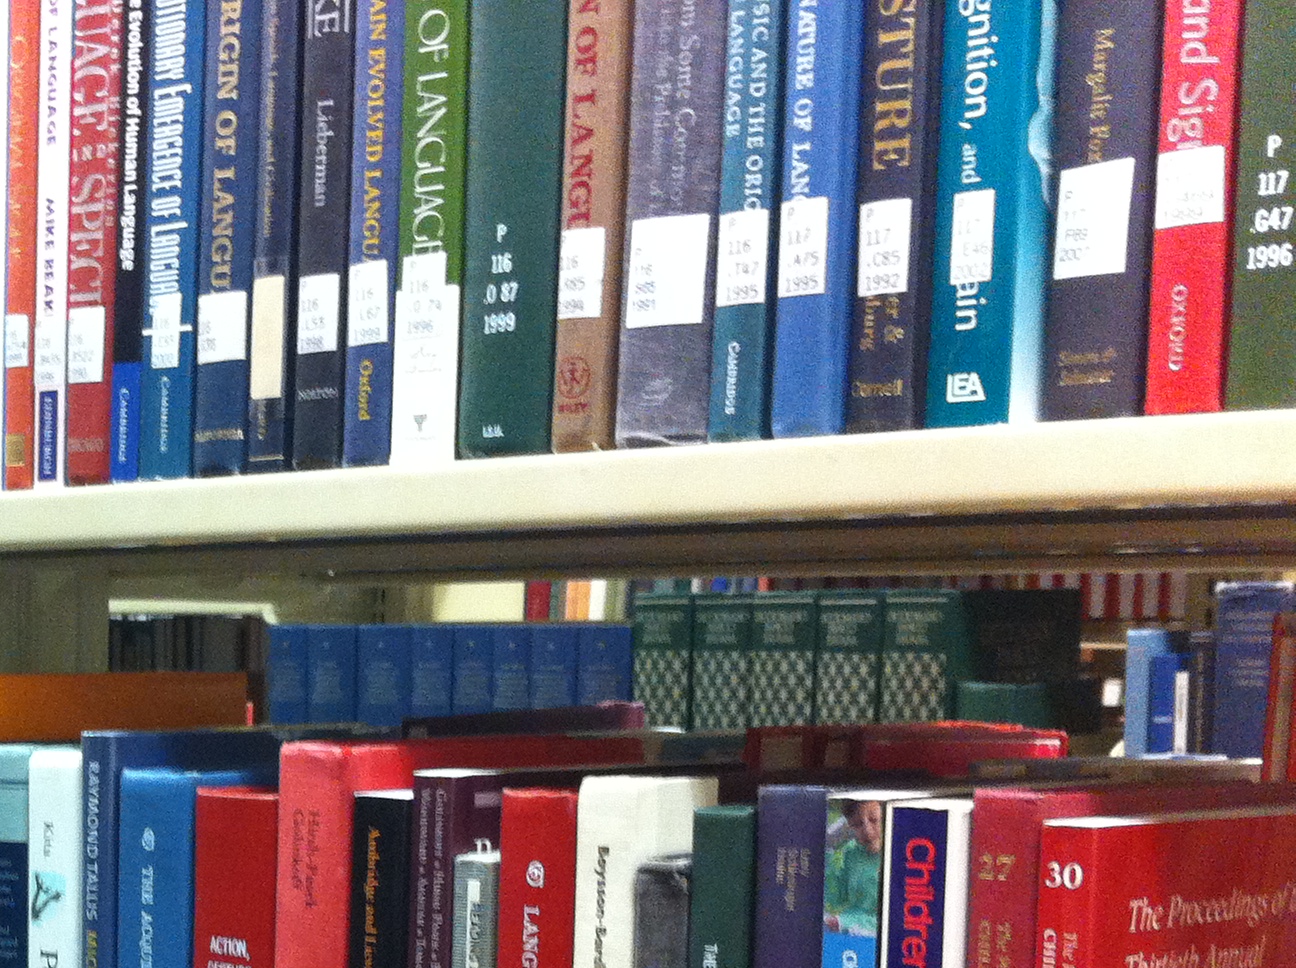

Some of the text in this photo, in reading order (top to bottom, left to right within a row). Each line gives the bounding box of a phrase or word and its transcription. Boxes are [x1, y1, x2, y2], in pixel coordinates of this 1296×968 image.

[416, 9, 449, 63] OF
[575, 27, 599, 76] OF
[46, 26, 58, 146] LANGUAGE
[726, 10, 745, 137] LANGUAGE
[1085, 28, 1116, 119] Margalit
[364, 50, 386, 162] EVOLVED
[747, 50, 768, 149] AND THE
[794, 98, 813, 132] OF
[119, 12, 142, 270] Evolution of Human Language
[214, 110, 238, 155] OF
[313, 99, 334, 207] Lieberman
[962, 144, 980, 184] and
[1257, 170, 1288, 196] 117
[44, 197, 55, 249] MIKE
[152, 196, 181, 216] OF
[727, 240, 752, 256] 116
[866, 229, 891, 246] 117
[1246, 244, 1293, 270] 1996
[491, 255, 512, 273] 116
[864, 274, 901, 291] 1992
[409, 281, 429, 294] 116
[484, 313, 515, 333] 1999
[1168, 284, 1189, 371] OXFORD
[357, 359, 374, 420] Oxford
[724, 341, 741, 415] CAMBRIDGE
[86, 761, 100, 862] RAYMOND
[140, 866, 154, 904] THE
[1044, 862, 1083, 889] 30
[1129, 896, 1165, 933] The
